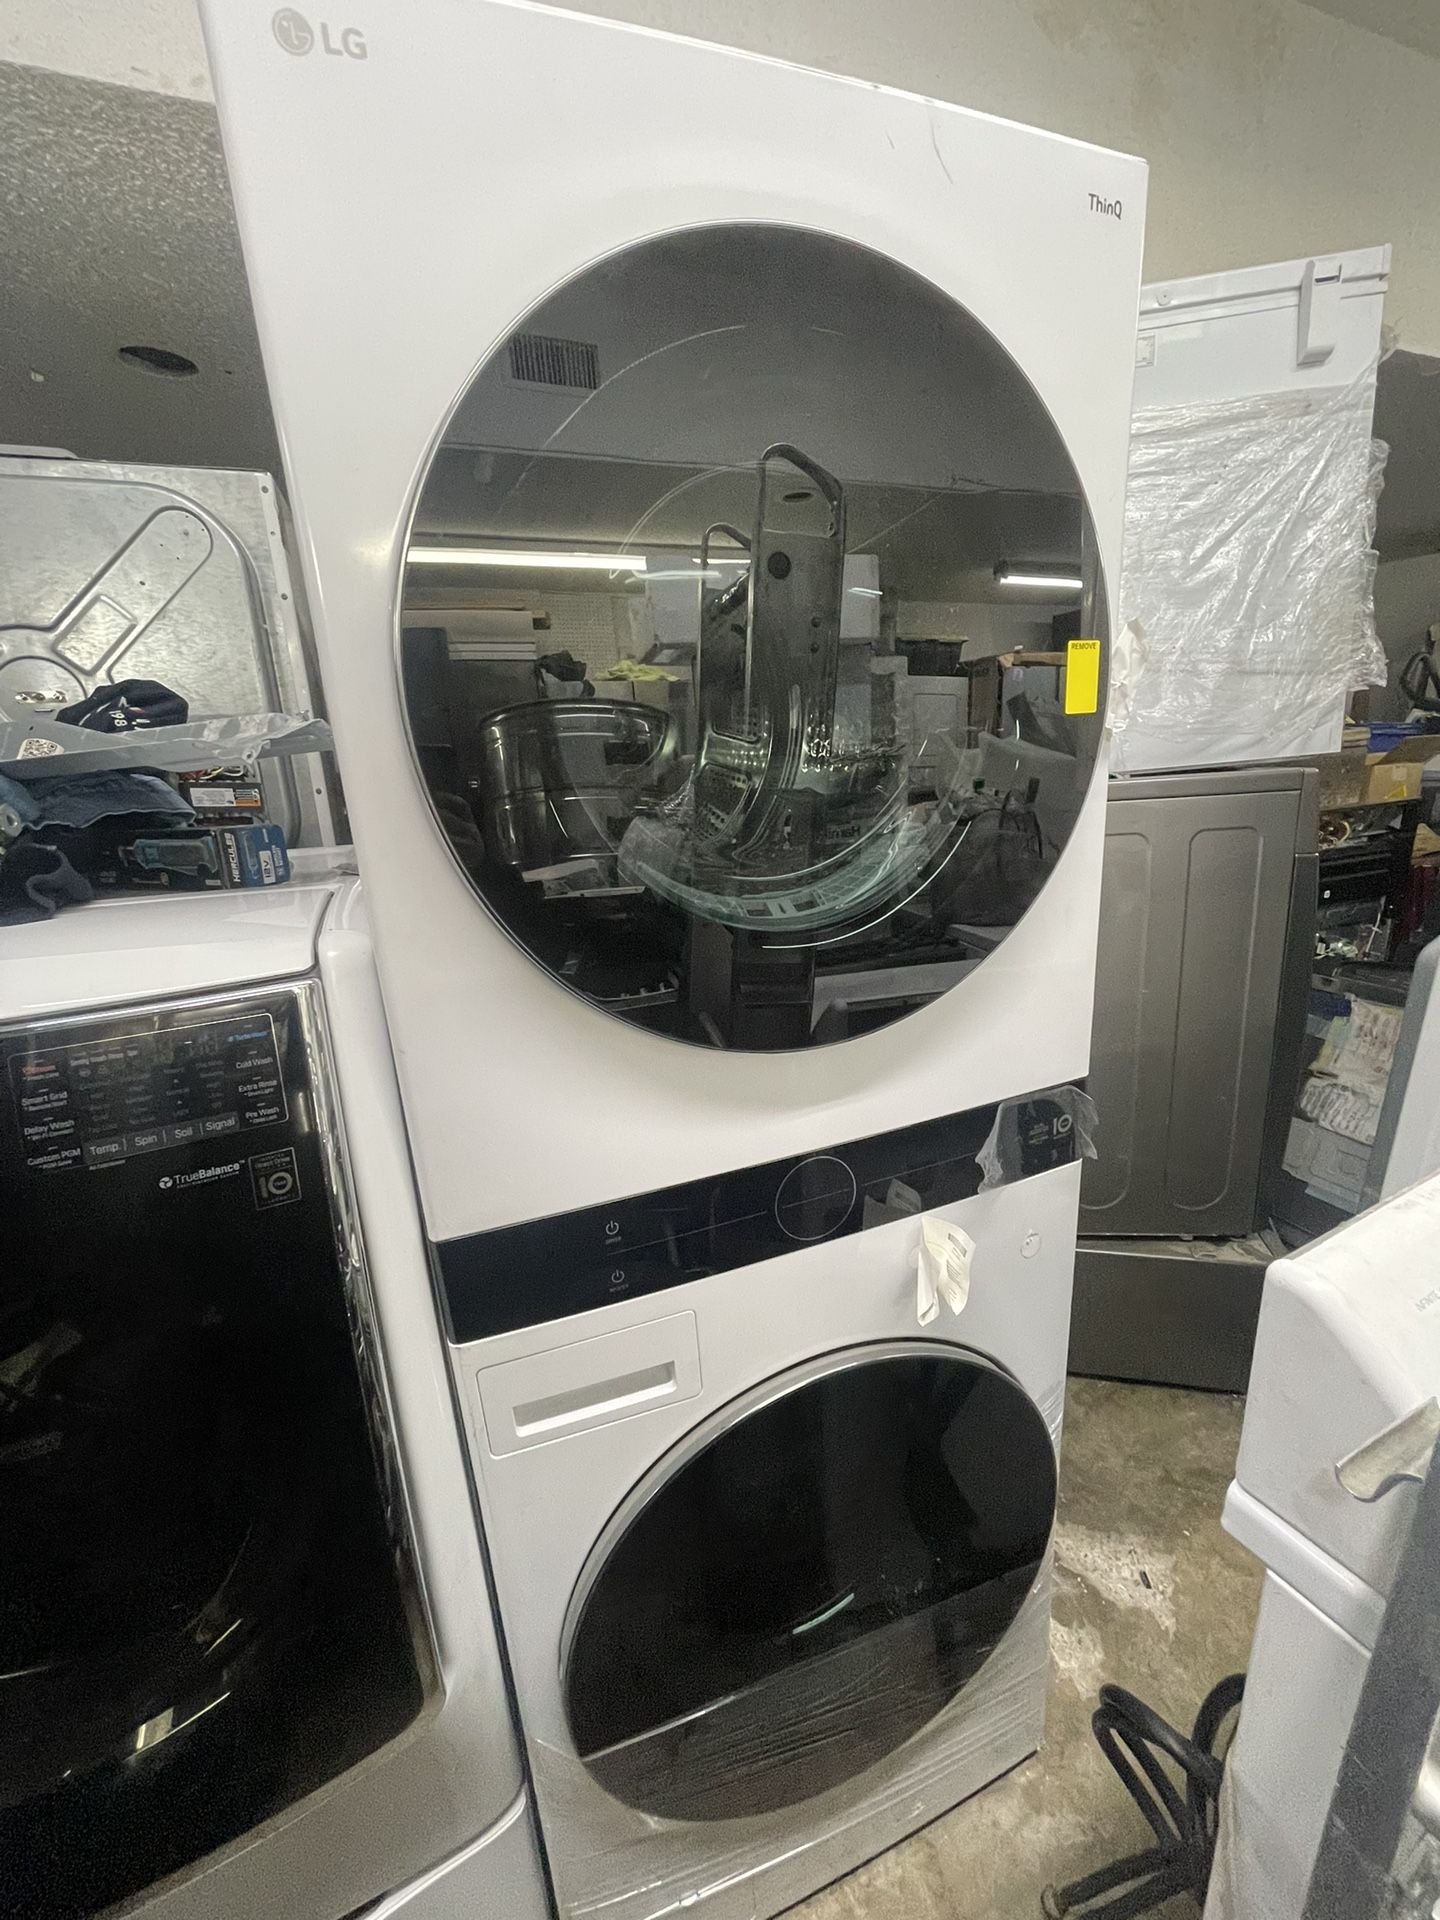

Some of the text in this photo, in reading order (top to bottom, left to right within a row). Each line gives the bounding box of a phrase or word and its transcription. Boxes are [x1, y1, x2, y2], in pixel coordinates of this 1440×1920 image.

[320, 22, 368, 60] LG
[1087, 192, 1122, 221] ThinQ
[1071, 642, 1097, 650] REMOVE
[224, 832, 241, 882] HERCULES
[252, 1056, 273, 1066] Wash
[238, 1083, 258, 1093] Extra
[245, 1111, 258, 1119] Pre
[258, 1106, 280, 1117] Wash
[24, 1126, 49, 1136] Delay
[49, 1120, 75, 1131] Wash
[135, 1135, 158, 1147] Spin
[174, 1126, 193, 1139] Soil
[206, 1116, 236, 1131] Signal
[1052, 1114, 1073, 1135] 10
[27, 1147, 81, 1166] Custom PGM
[260, 1172, 293, 1198] 10
